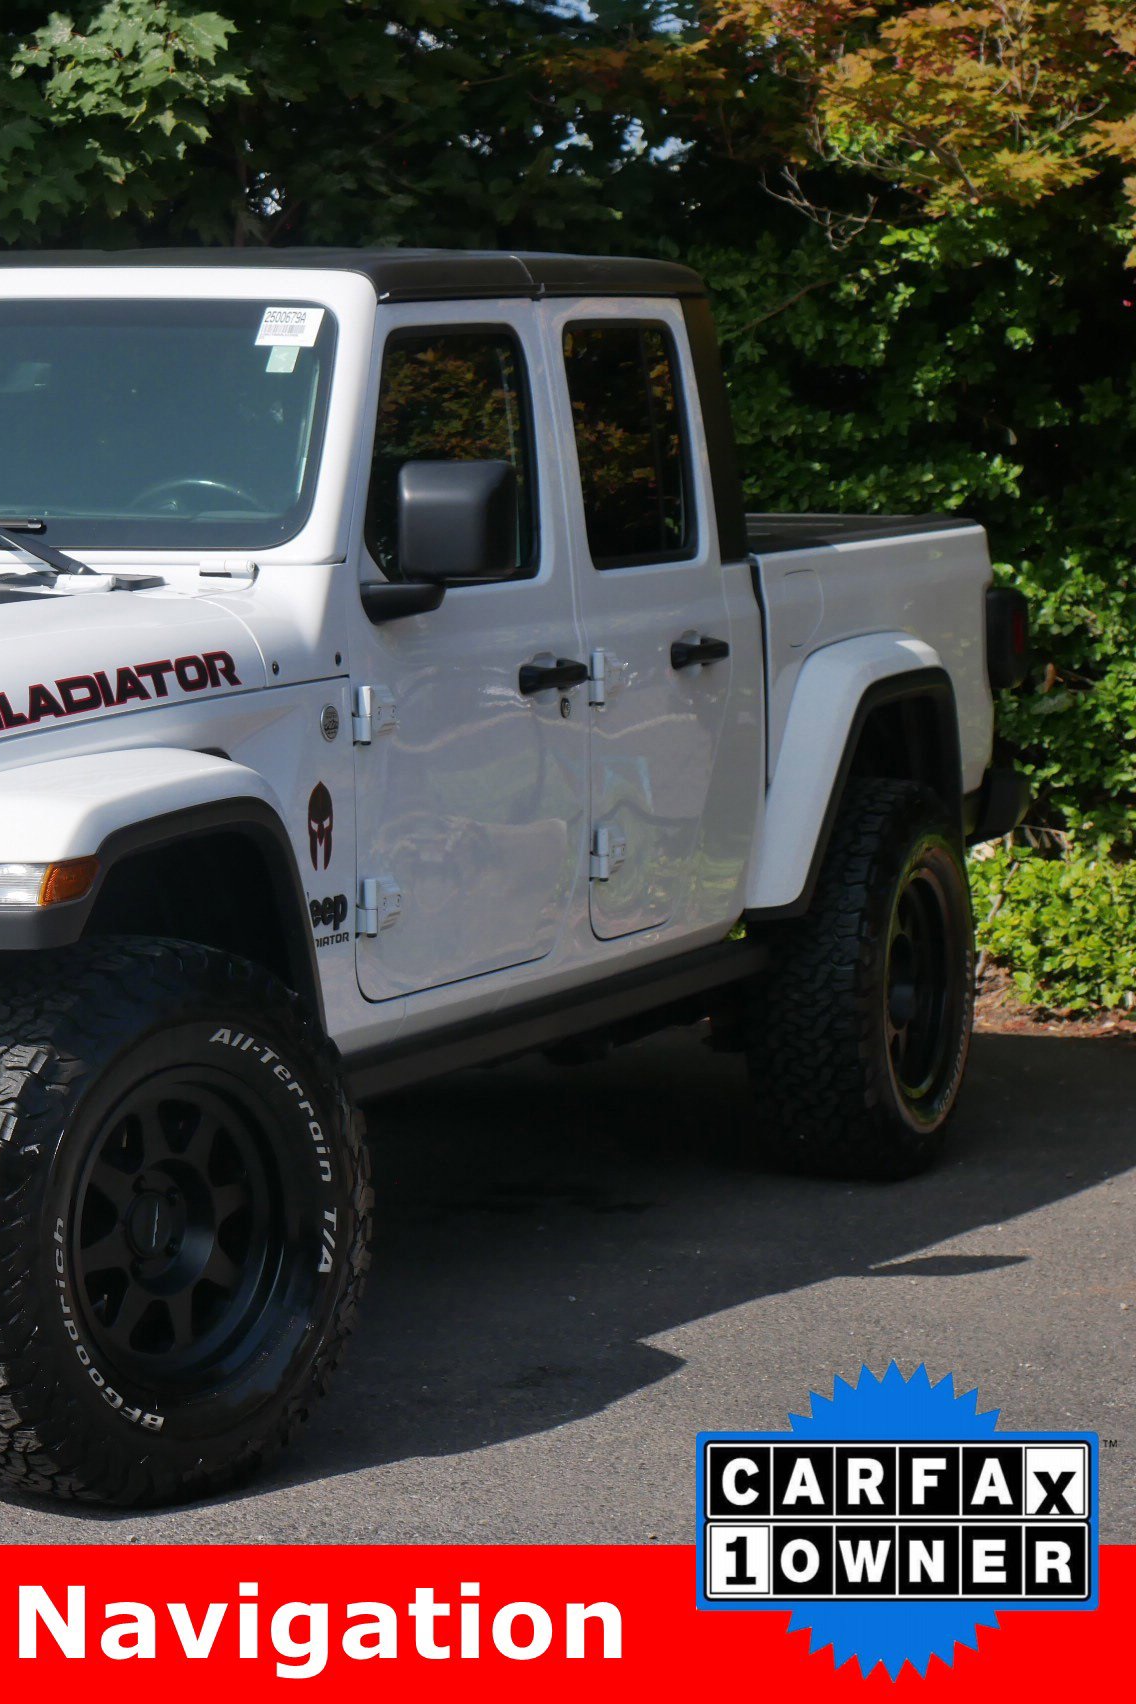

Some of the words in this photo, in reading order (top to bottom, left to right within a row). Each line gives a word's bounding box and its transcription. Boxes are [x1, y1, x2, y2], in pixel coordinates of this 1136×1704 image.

[307, 891, 348, 931] eep
[209, 1027, 333, 1182] All-Terrain
[317, 1207, 338, 1274] T/A
[53, 1217, 166, 1432] BFGoodrich
